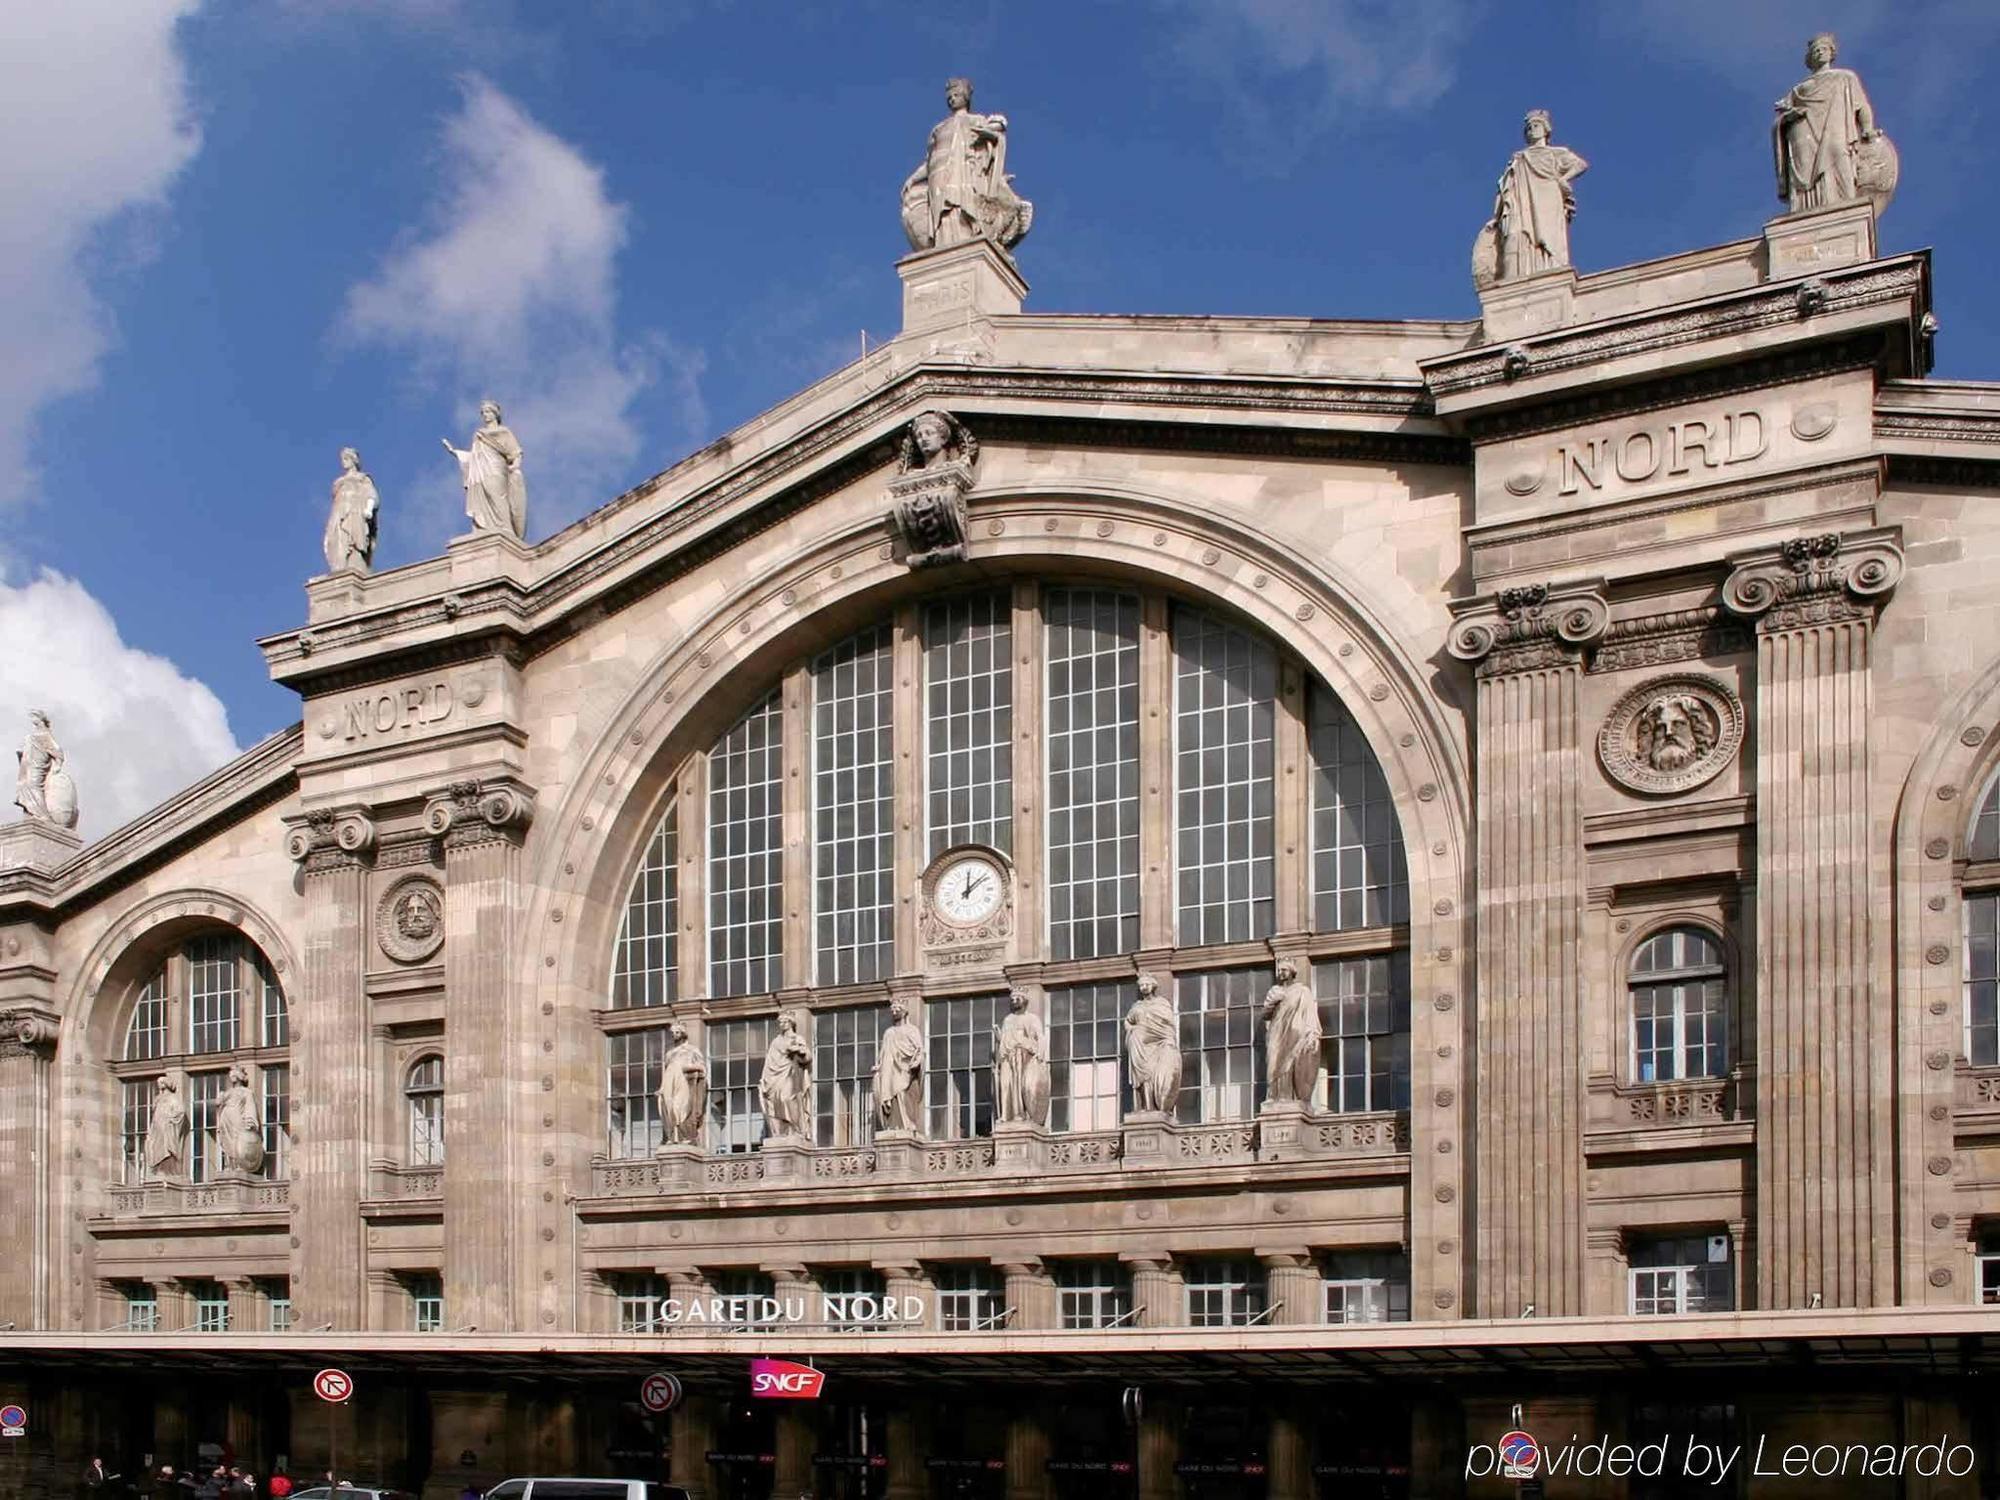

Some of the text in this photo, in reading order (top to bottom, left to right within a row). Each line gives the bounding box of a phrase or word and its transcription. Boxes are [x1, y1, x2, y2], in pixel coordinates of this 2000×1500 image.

[1558, 411, 1769, 497] NORD
[344, 684, 453, 741] NORD
[660, 1296, 925, 1322] GARE DU NORD
[753, 1373, 817, 1392] SNCF
